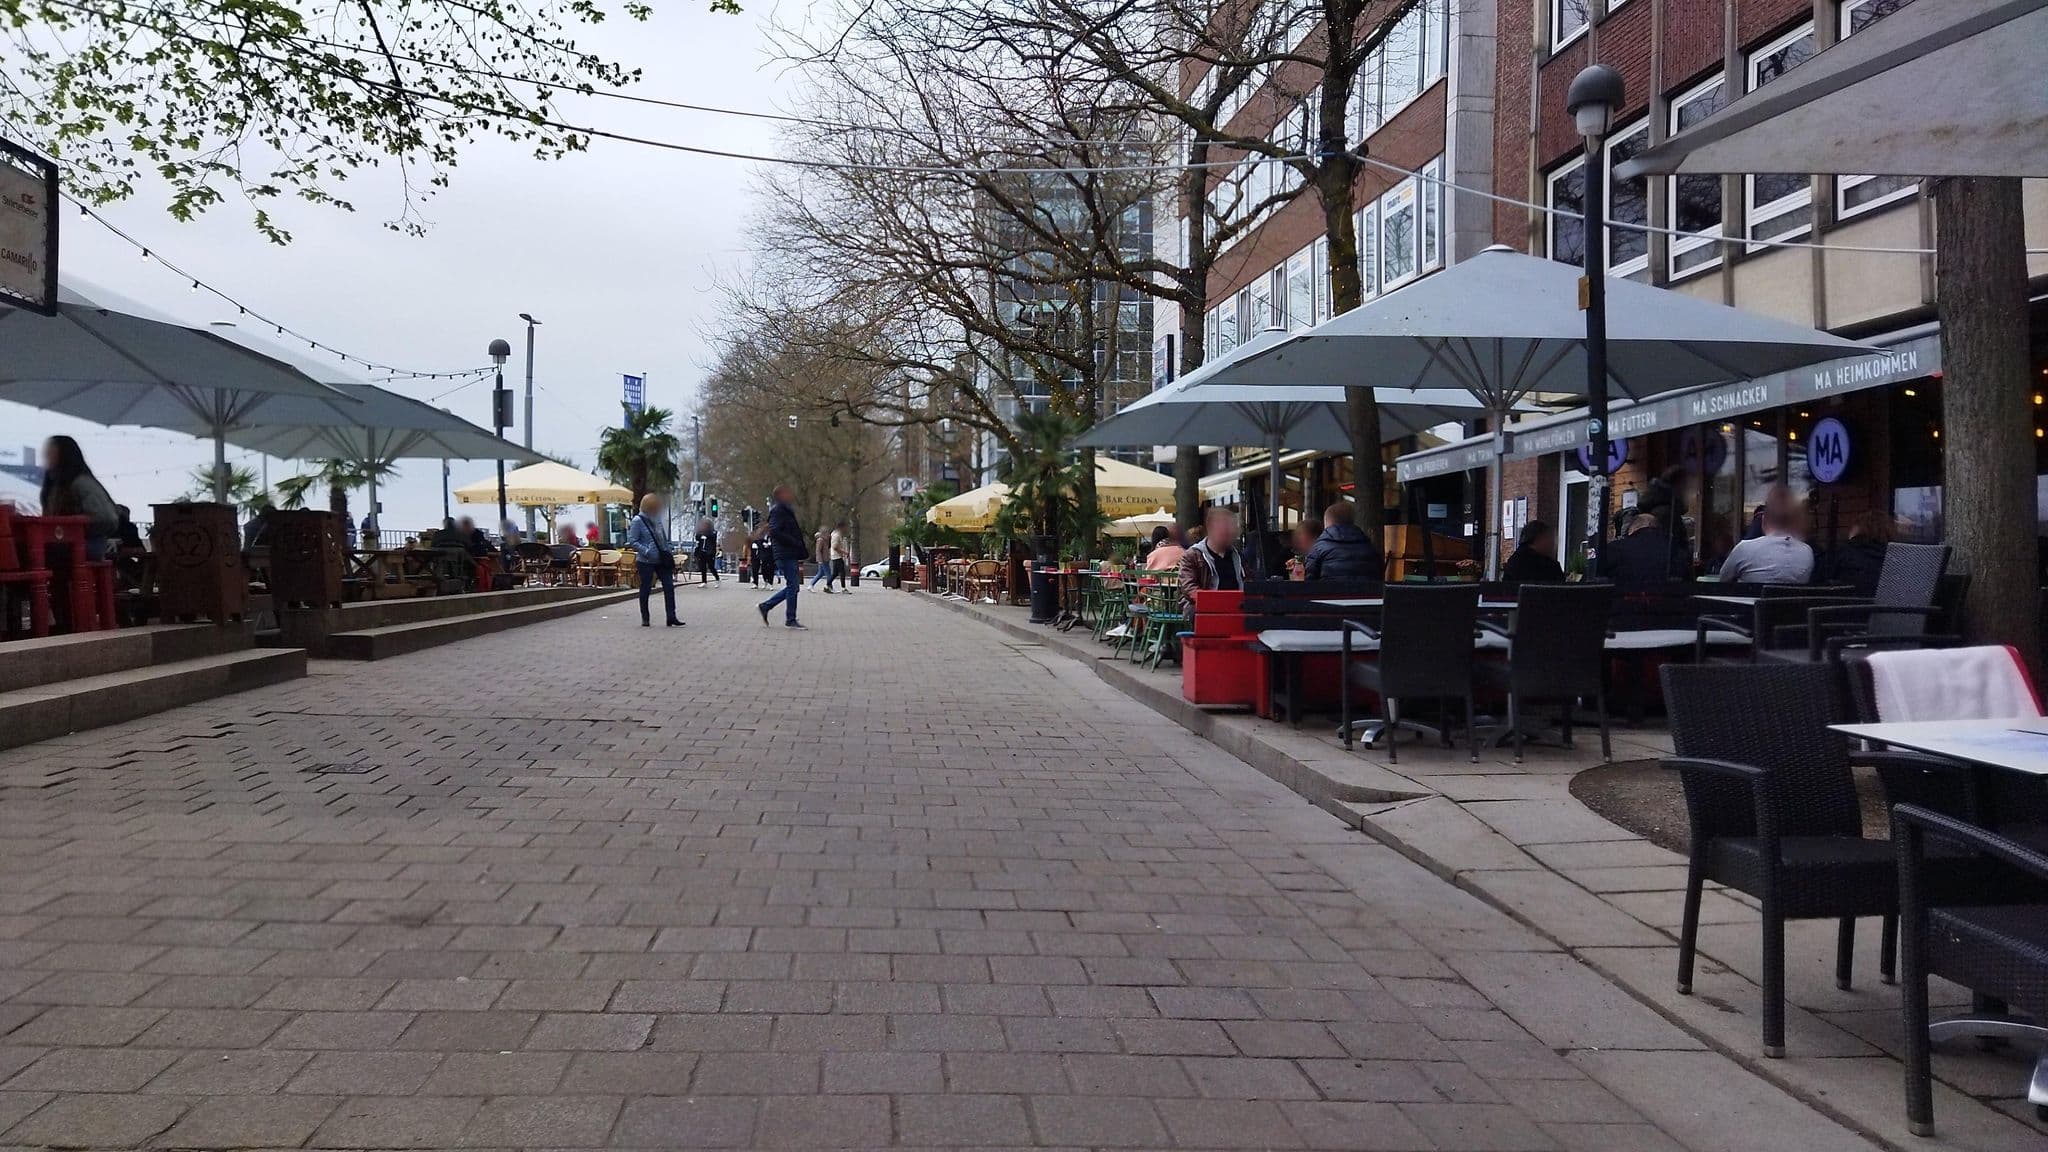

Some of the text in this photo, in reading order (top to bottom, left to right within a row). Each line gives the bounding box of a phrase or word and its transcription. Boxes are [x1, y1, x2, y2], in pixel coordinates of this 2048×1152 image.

[1815, 350, 1917, 390] MA HEIMKOMMEN
[1693, 385, 1767, 416] MA SCHNACKEN
[1815, 432, 1843, 466] MA
